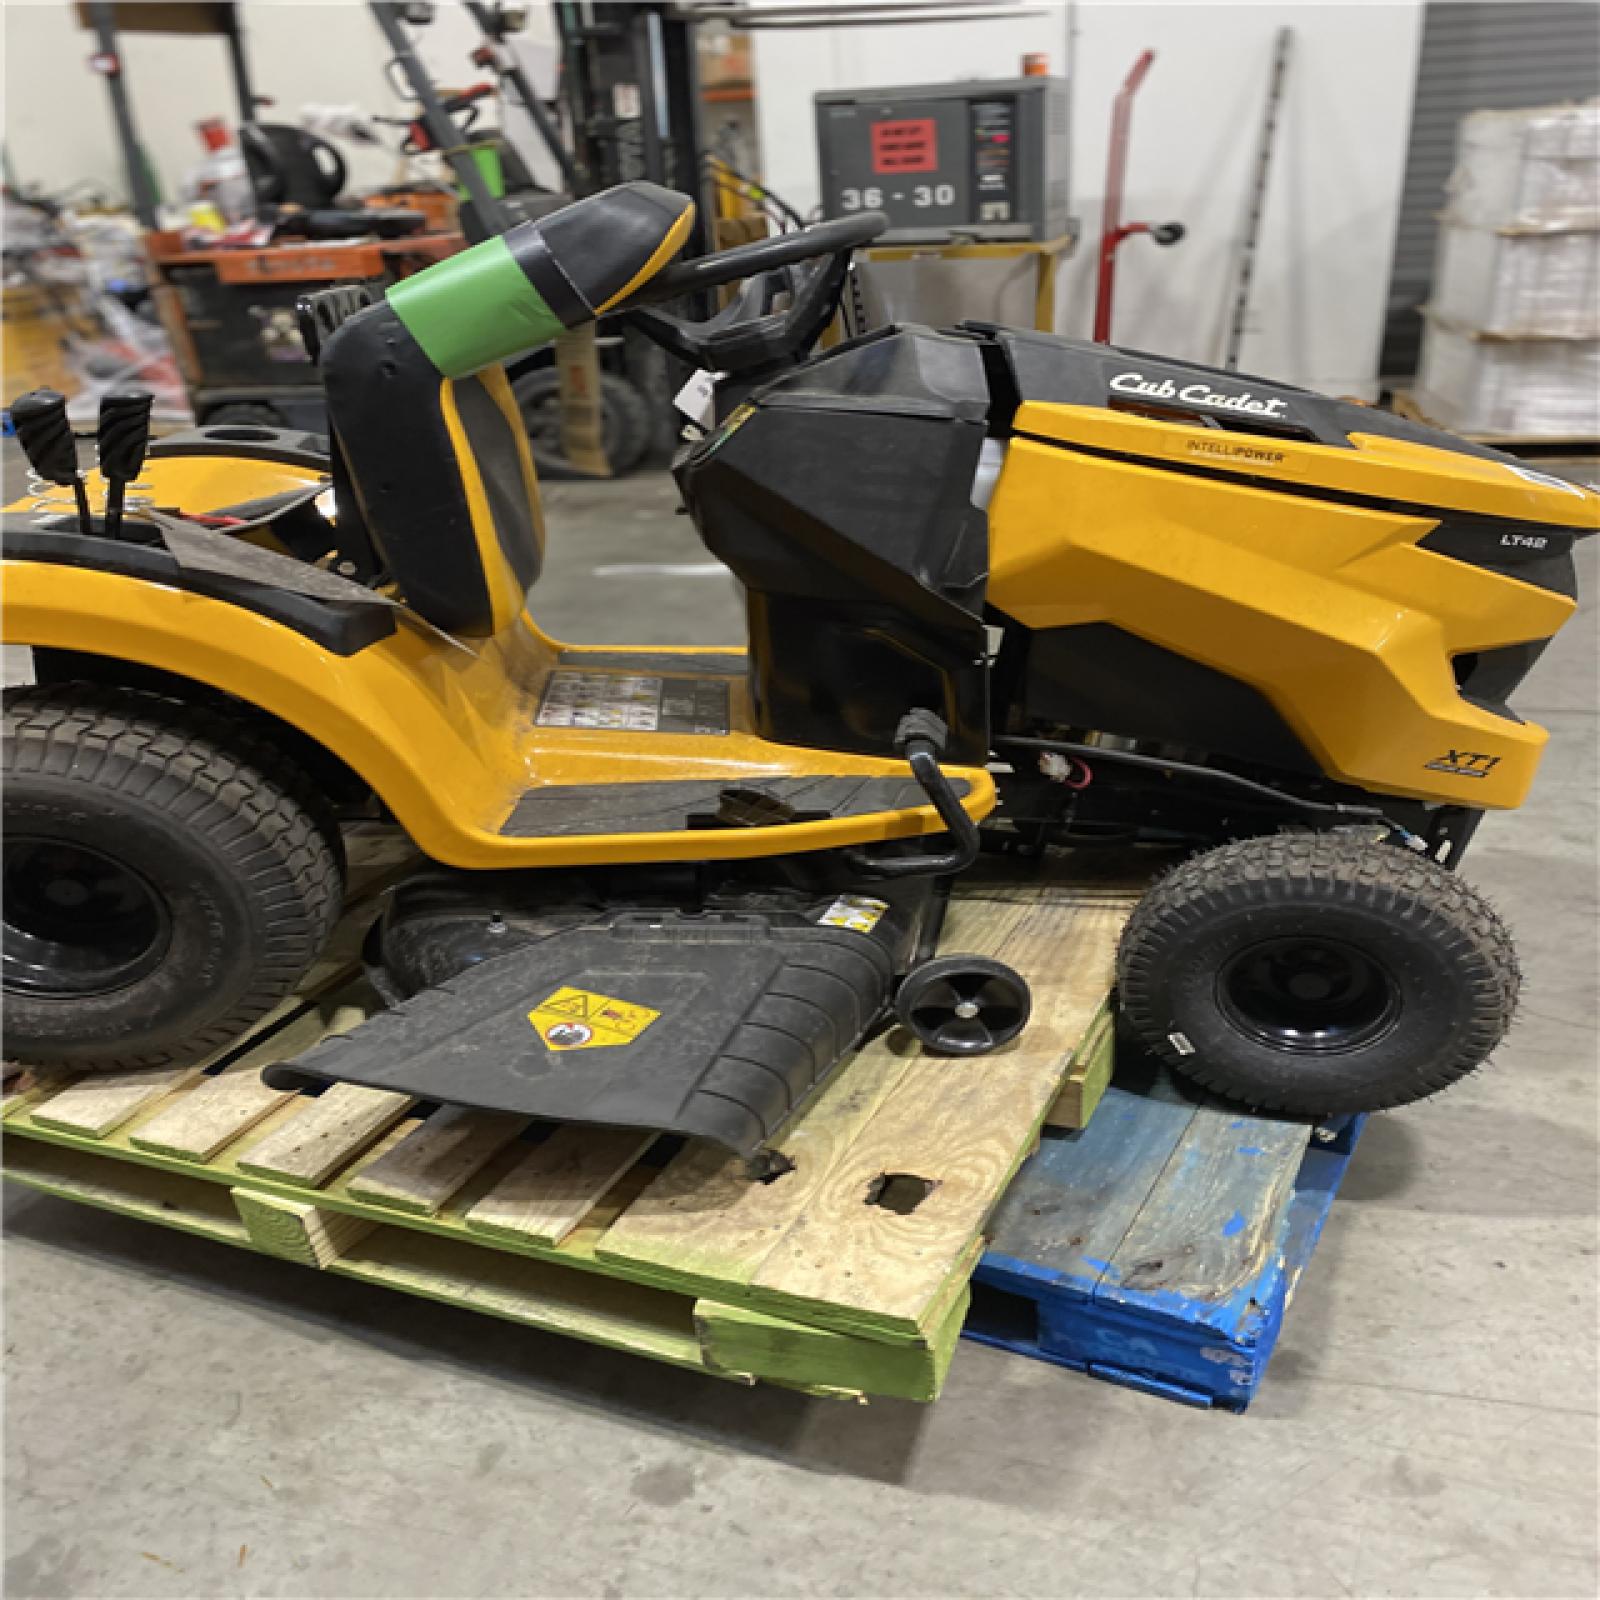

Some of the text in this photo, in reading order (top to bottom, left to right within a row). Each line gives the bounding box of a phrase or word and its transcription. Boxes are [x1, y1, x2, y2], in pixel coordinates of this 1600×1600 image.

[912, 184, 955, 207] 30
[1109, 373, 1288, 417] Cub Cadet
[1185, 438, 1285, 463] INTELLIPOWER
